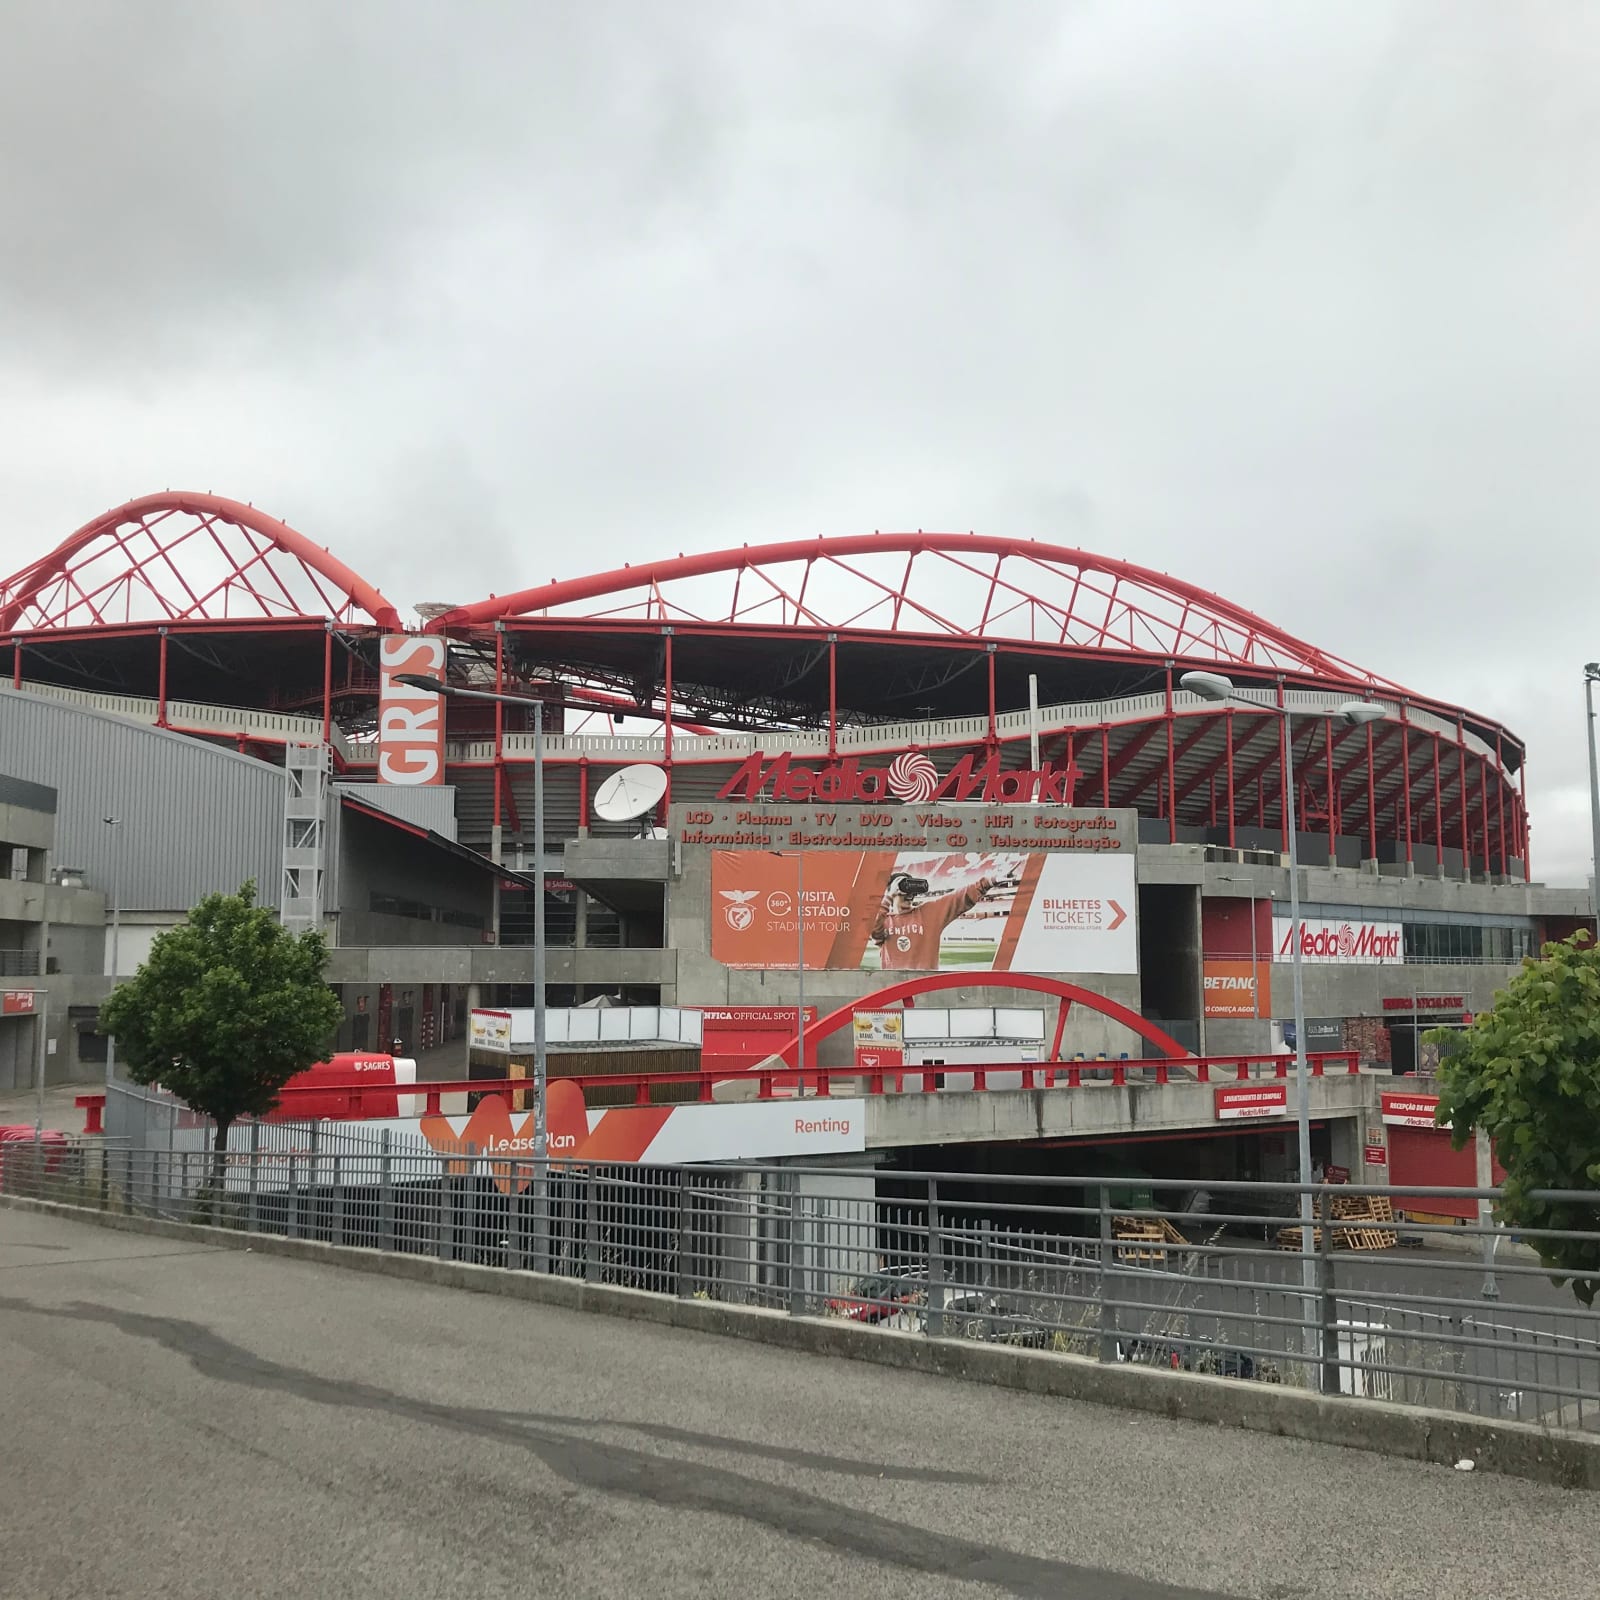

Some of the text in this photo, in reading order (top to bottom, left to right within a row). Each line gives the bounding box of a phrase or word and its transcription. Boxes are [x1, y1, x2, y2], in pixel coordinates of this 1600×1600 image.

[715, 750, 1084, 804] Media Markt
[686, 811, 714, 825] LCD
[735, 811, 793, 826] Plasma
[815, 813, 836, 826] TV
[860, 813, 893, 827] DVD
[984, 815, 1013, 829] HiFi
[1033, 815, 1117, 833] Fotografia
[680, 829, 1121, 853] Informática Electrodomésticos CD Telecomunicação
[797, 891, 836, 902] VISITA
[797, 904, 850, 917] ESTÁDIO
[1043, 899, 1102, 910] BILHETES
[1042, 911, 1103, 924] TICKETS
[766, 921, 850, 932] STADIUM TOUR
[1280, 922, 1400, 957] Media Markt
[733, 1011, 773, 1020] OFFICIAL
[773, 1011, 796, 1020] SPOT
[1211, 1006, 1237, 1014] COMEÇA
[363, 1061, 391, 1072] SAGRES
[795, 1117, 850, 1135] Renting
